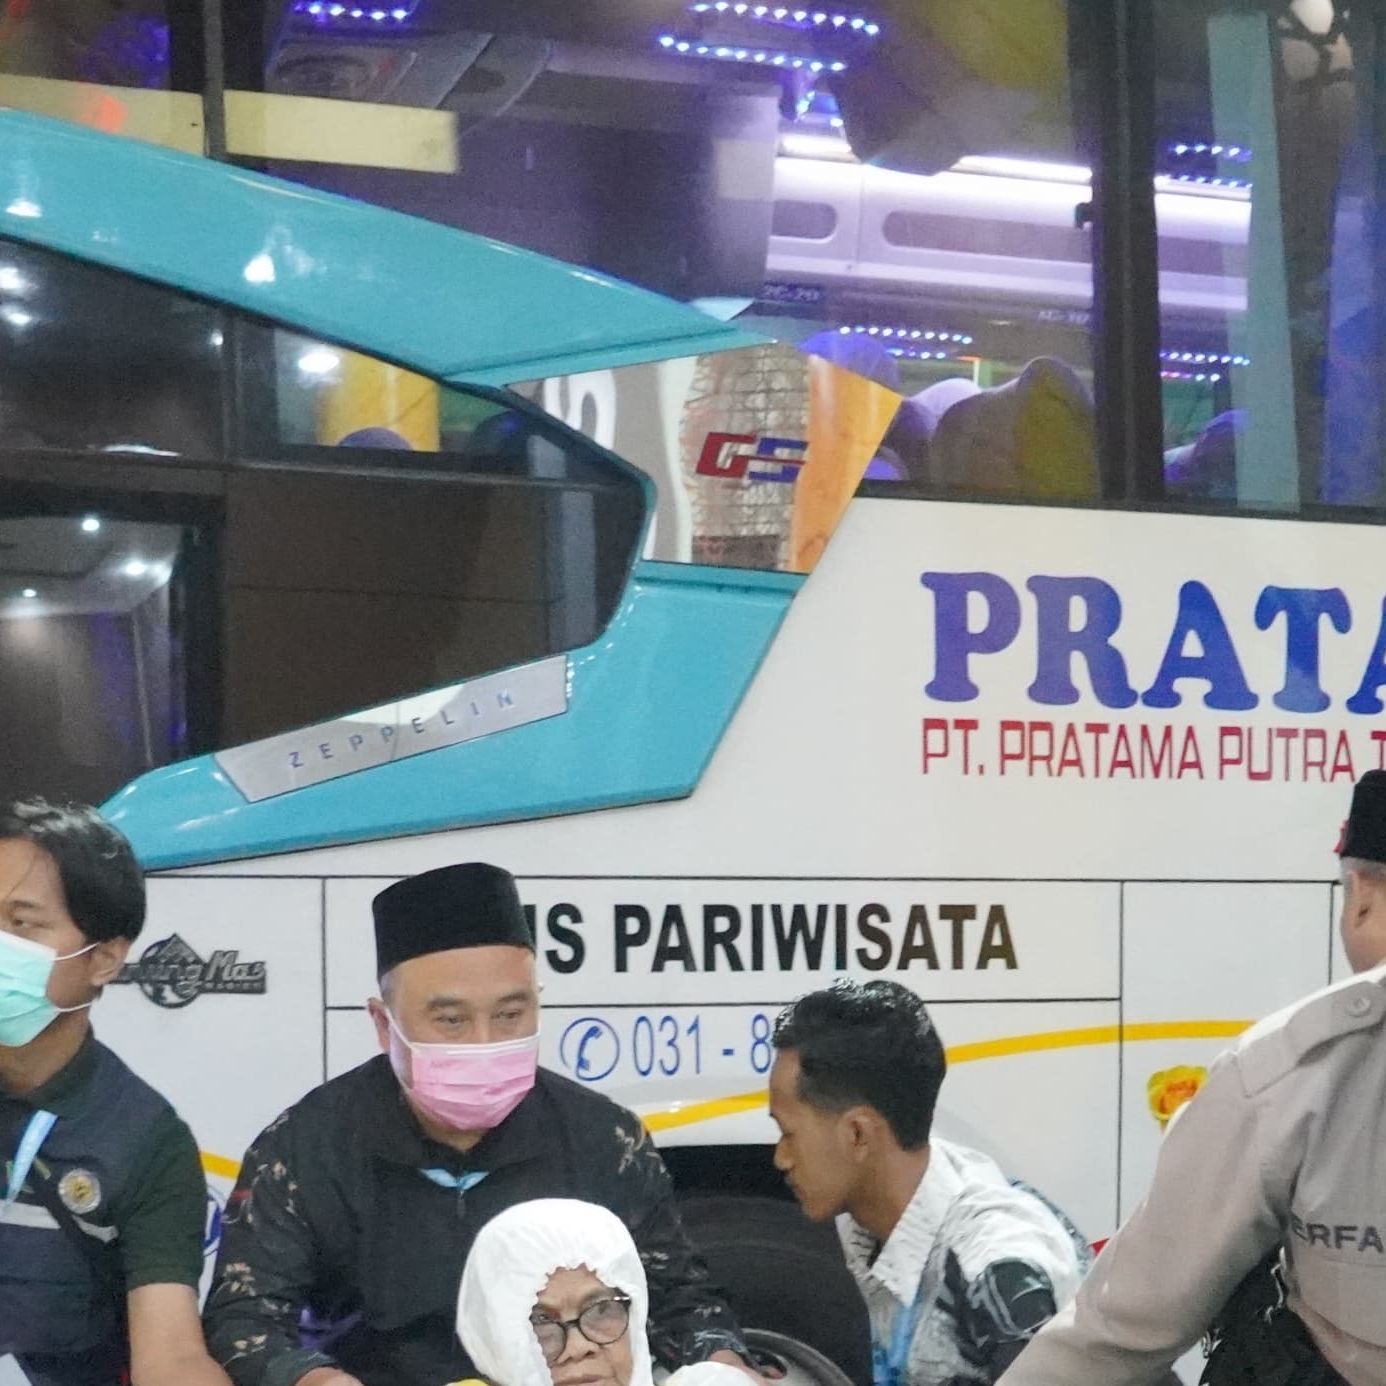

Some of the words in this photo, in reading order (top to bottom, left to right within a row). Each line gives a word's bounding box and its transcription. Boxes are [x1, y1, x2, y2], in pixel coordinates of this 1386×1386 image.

[289, 690, 515, 769] ZEPPELIN
[922, 718, 986, 776] PT.
[999, 720, 1205, 779] PRATAMA
[1219, 725, 1357, 782] PUTRA
[614, 901, 1019, 974] PARIWISATA
[632, 1014, 701, 1077] 031
